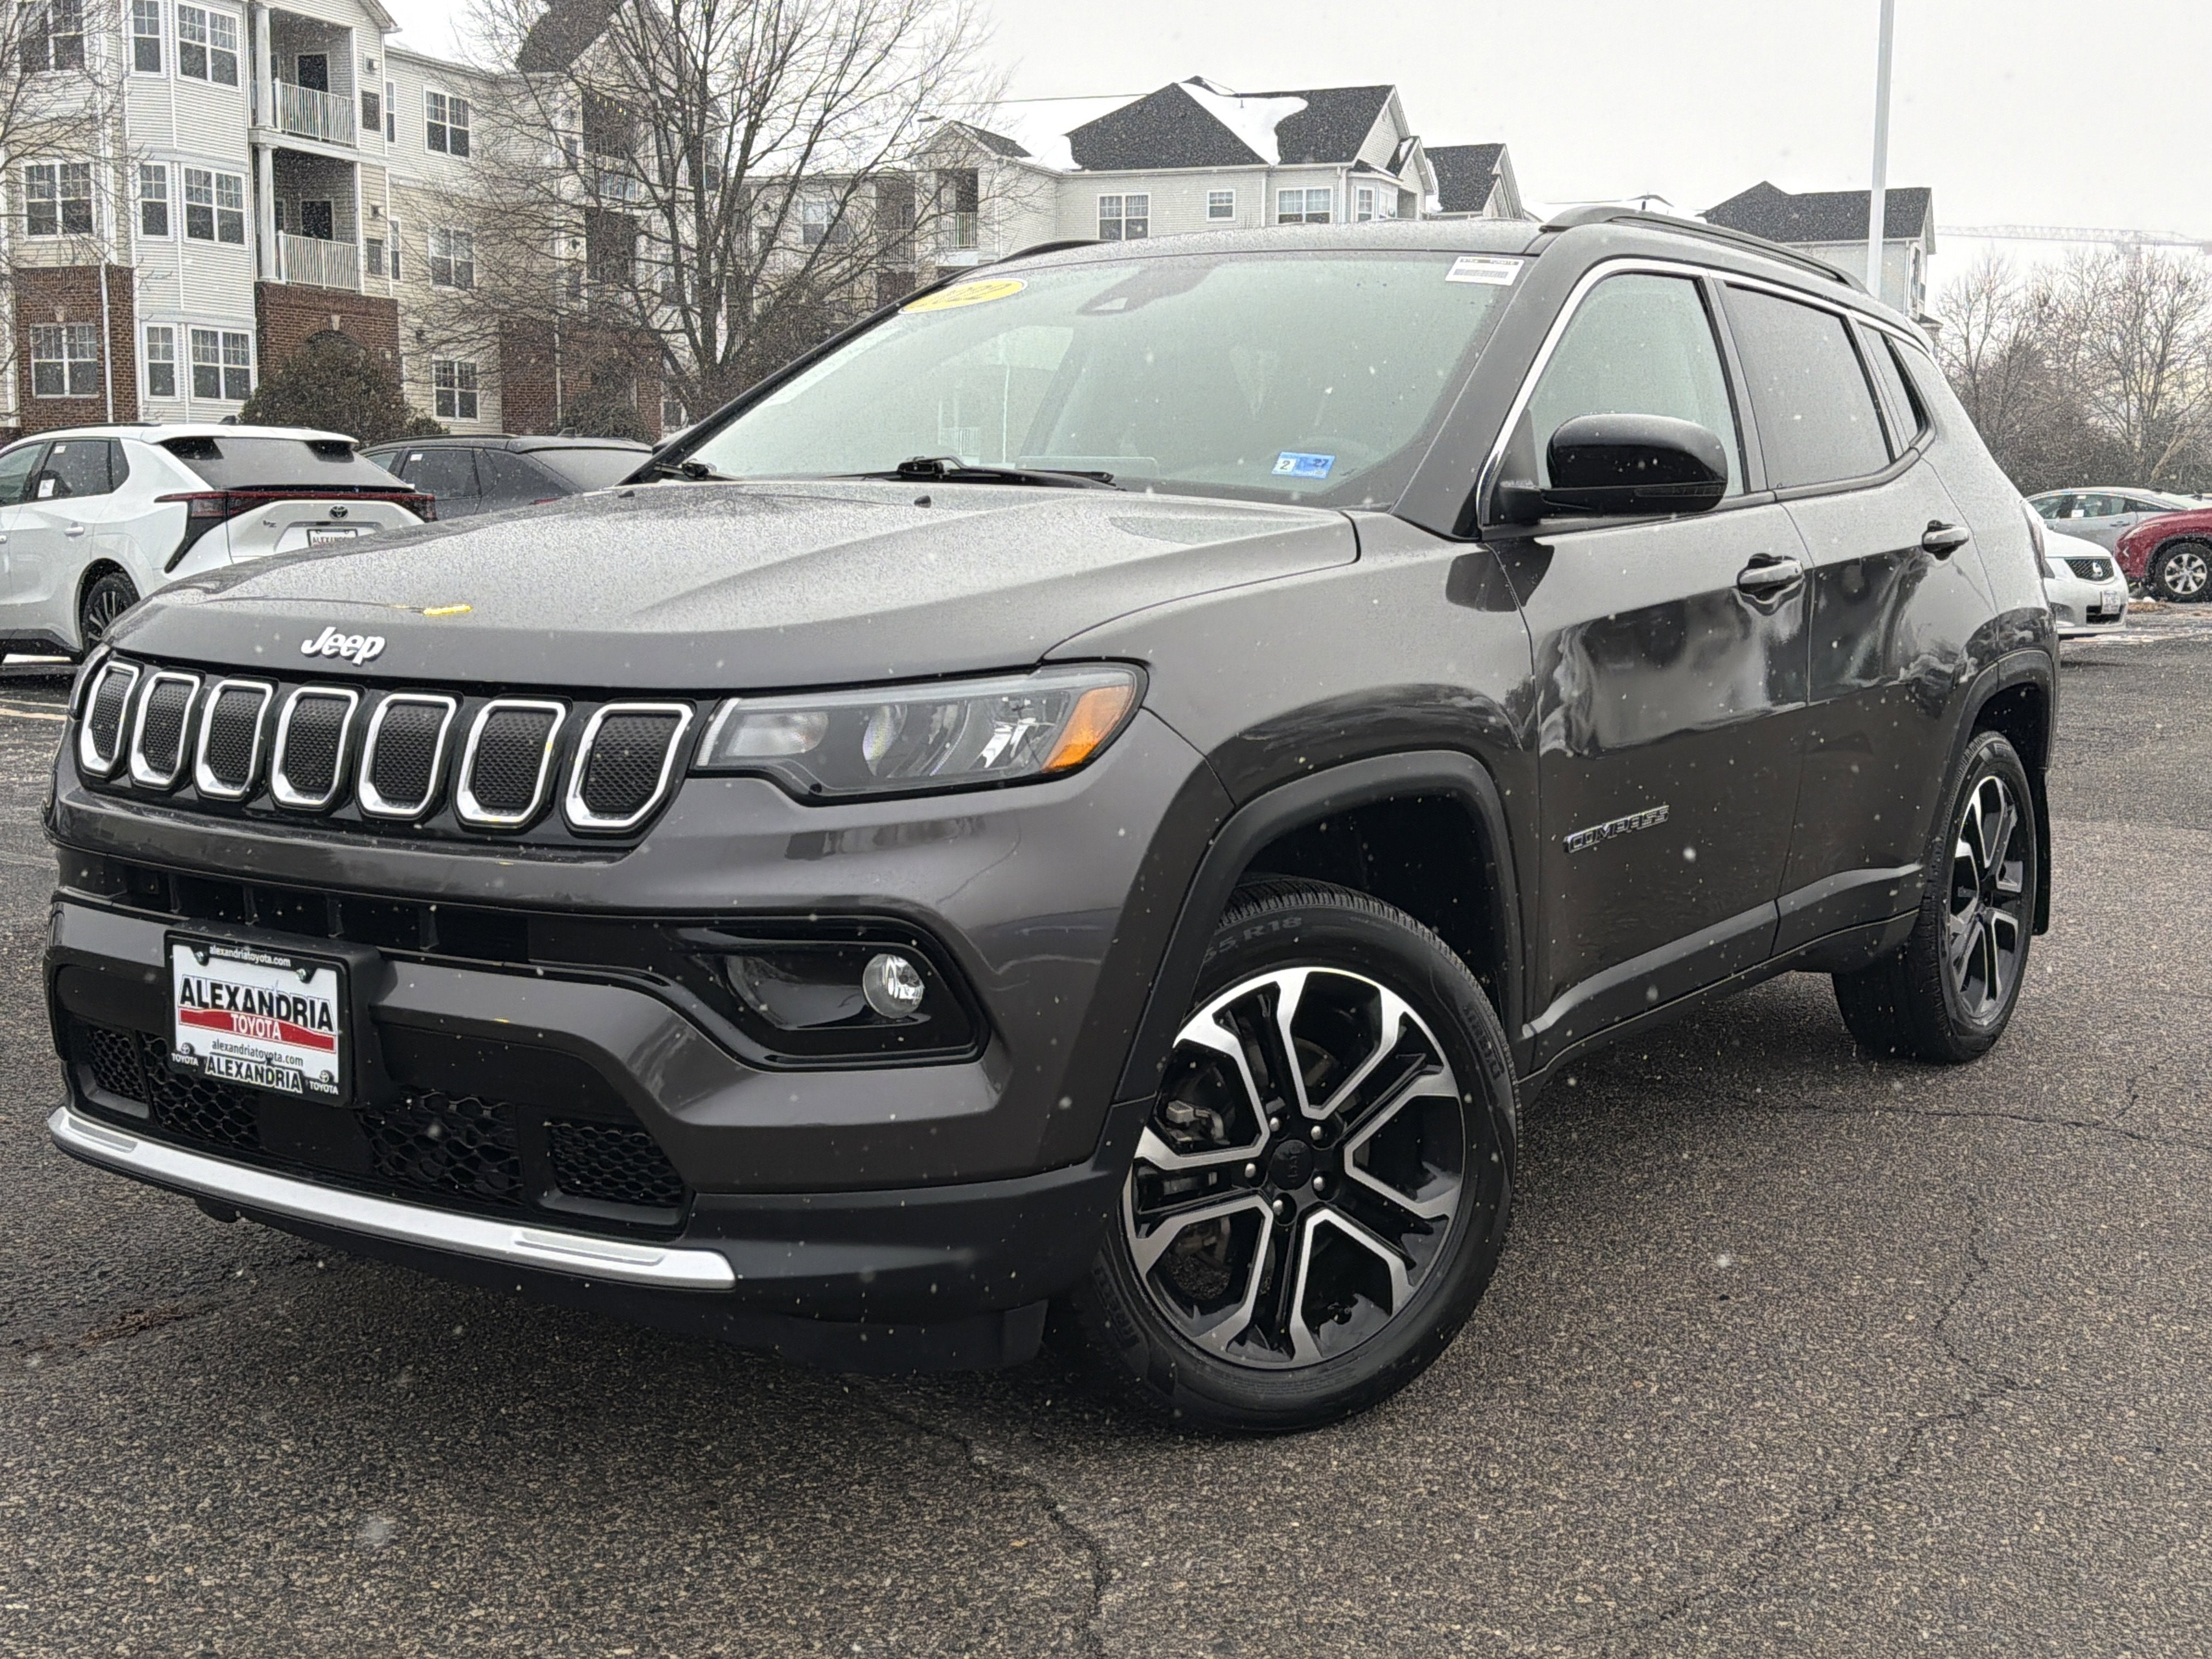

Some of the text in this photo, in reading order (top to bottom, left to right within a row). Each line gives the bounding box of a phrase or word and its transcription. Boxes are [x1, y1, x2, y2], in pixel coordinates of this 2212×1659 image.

[1279, 460, 1290, 470] 2
[301, 627, 386, 666] Jeep
[1565, 805, 1669, 853] COMPASS
[1243, 917, 1302, 941] R18
[209, 944, 291, 967] alexandriatoyota.com
[180, 977, 335, 1032] ALEXANDRIA
[230, 1014, 282, 1040] TOYOTA
[171, 1053, 199, 1066] TOYOTA
[212, 1038, 303, 1067] alexandriatoyota.com
[206, 1057, 303, 1093] ALEXANDRIA
[309, 1080, 339, 1094] TOYOTA
